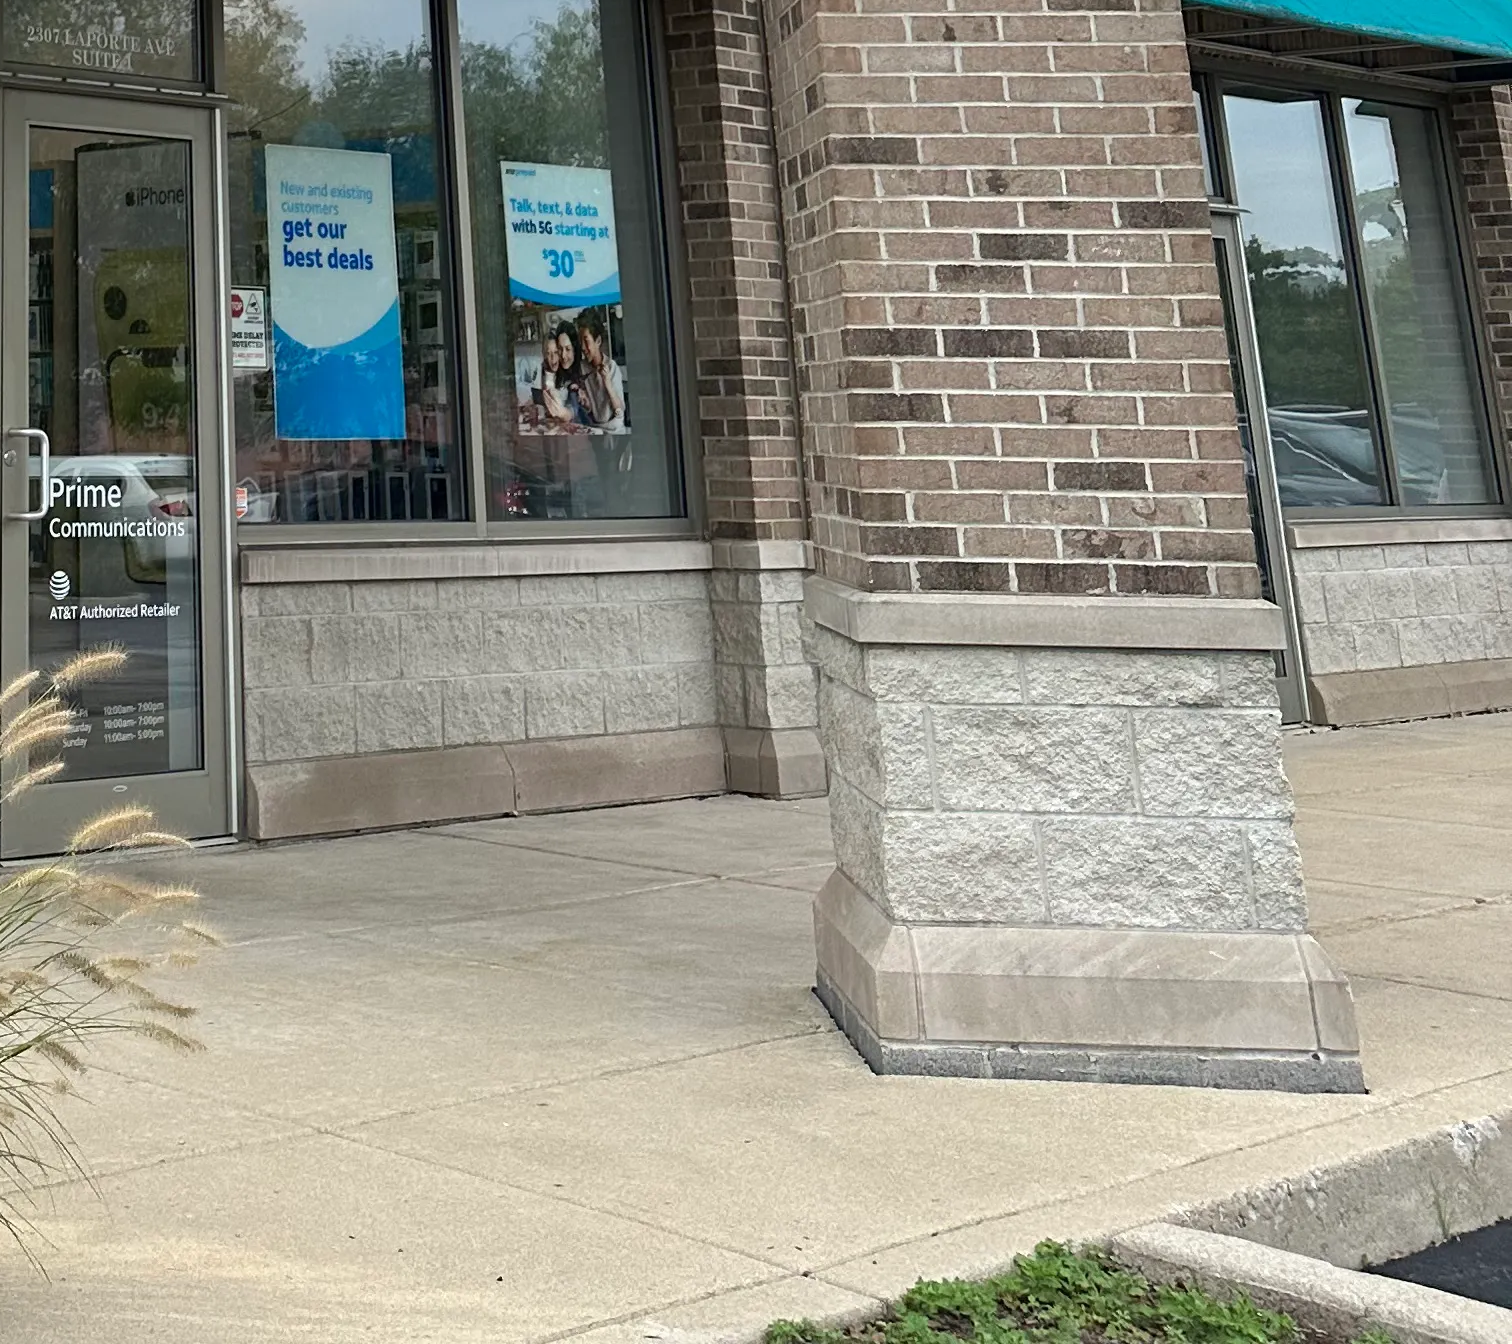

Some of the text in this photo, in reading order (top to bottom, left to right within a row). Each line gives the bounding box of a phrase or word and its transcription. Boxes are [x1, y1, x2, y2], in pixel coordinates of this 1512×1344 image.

[27, 25, 176, 56] 2307 LAPORTE AVE
[136, 187, 185, 206] iPhone
[280, 180, 373, 204] New and existing
[281, 200, 339, 216] customers
[509, 198, 599, 218] Talk, text, & data
[282, 217, 347, 243] get our
[511, 218, 610, 241] with 5G starting at
[283, 244, 374, 271] best deals
[49, 477, 122, 508] Prime
[49, 517, 185, 538] Communications
[49, 601, 181, 621] AT&T Authorized Retailer
[62, 736, 88, 748] Sunday
